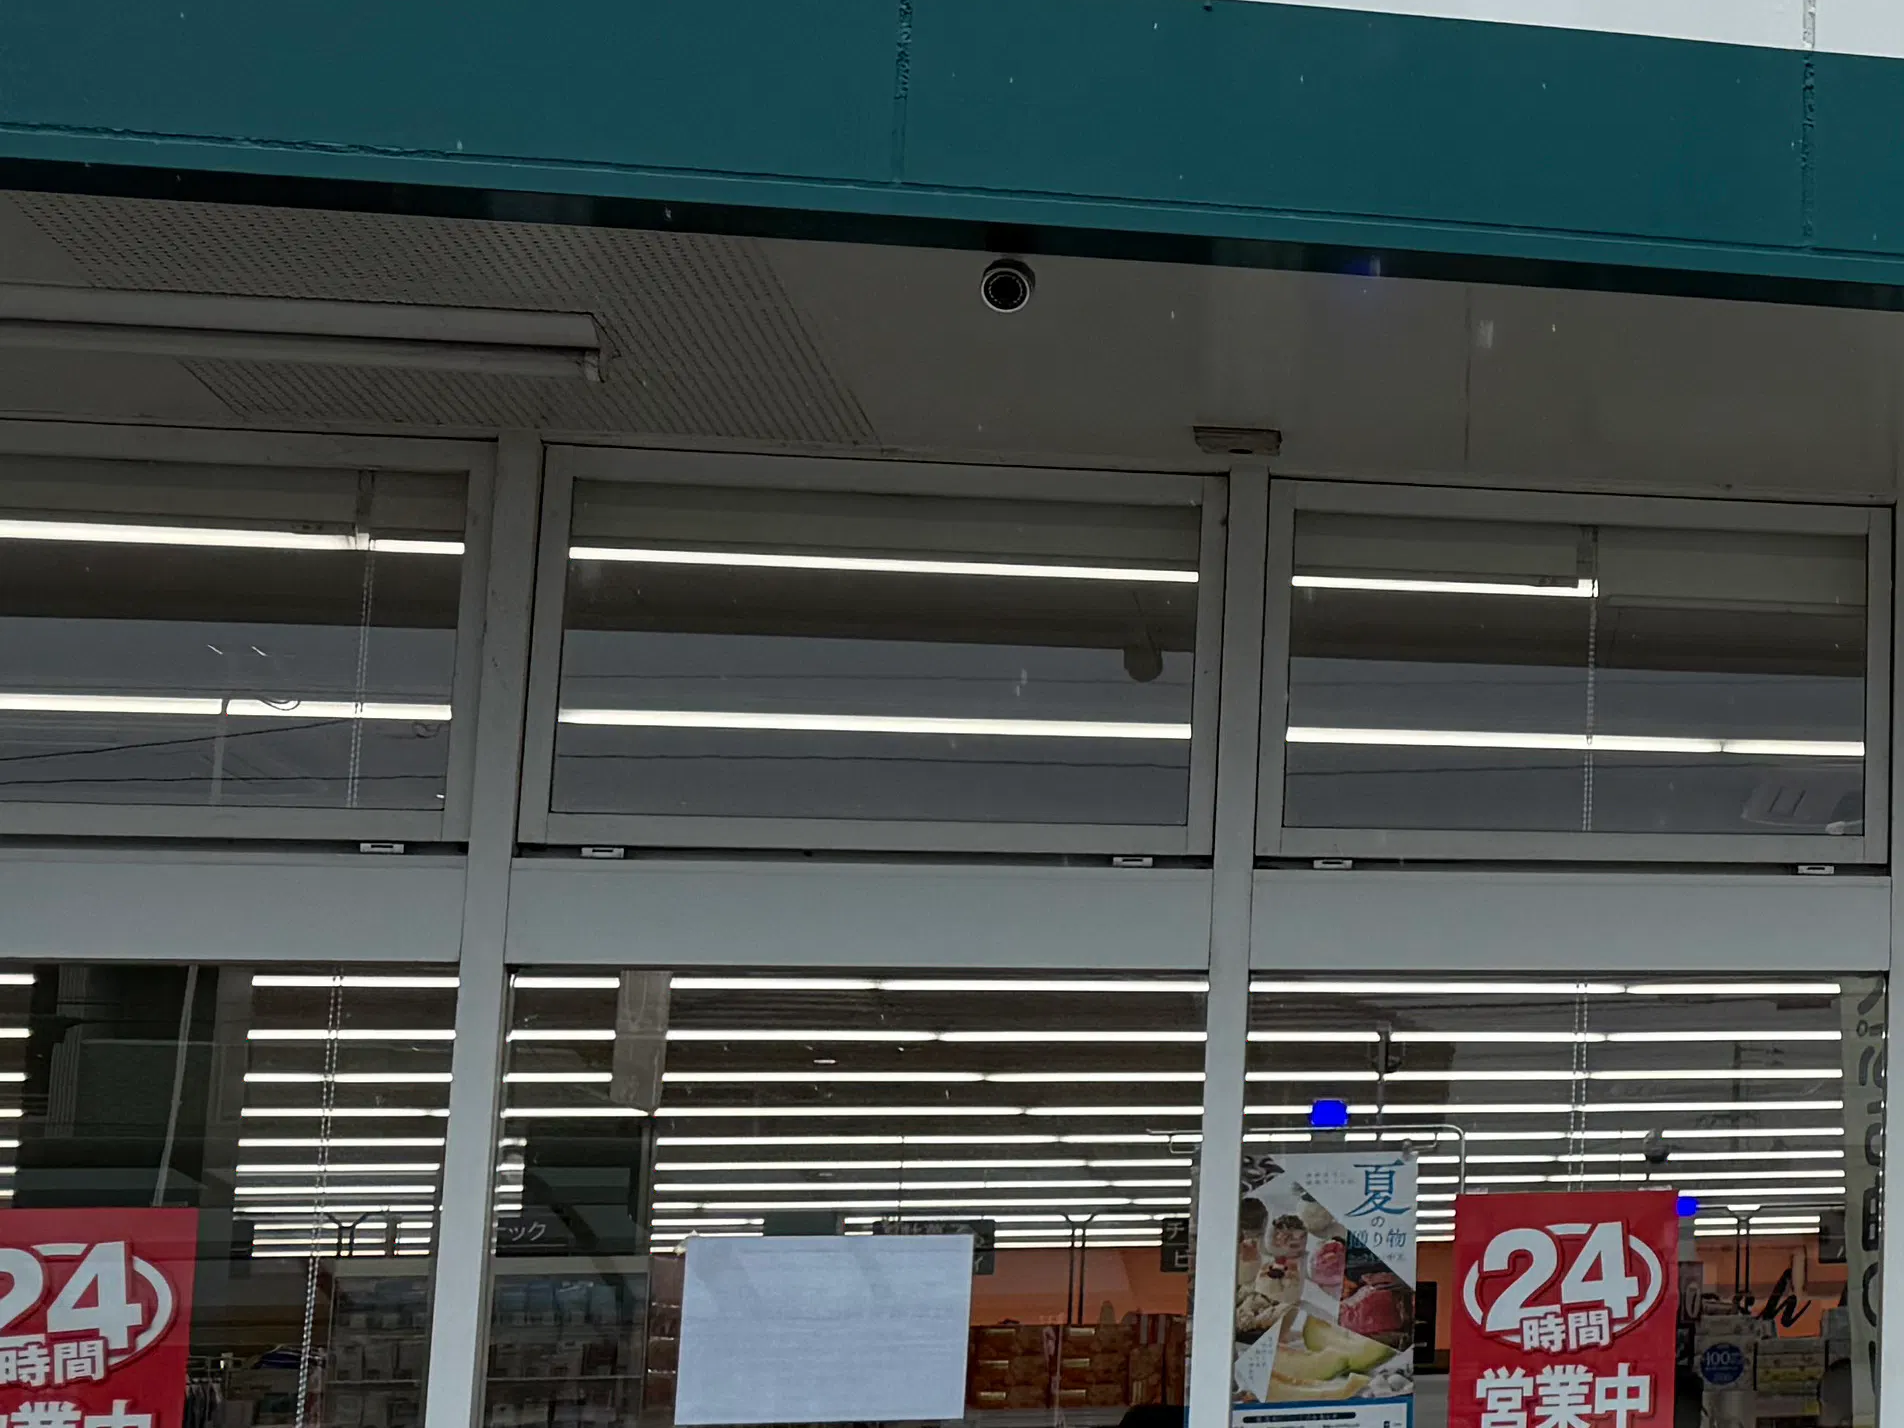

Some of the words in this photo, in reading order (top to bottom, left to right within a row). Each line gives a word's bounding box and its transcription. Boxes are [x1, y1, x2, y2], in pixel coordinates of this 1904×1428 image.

[1345, 1159, 1412, 1217] 夏
[497, 1221, 546, 1243] ック
[1483, 1222, 1640, 1333] 24
[1521, 1309, 1613, 1353] 時間
[0, 1339, 105, 1386] 時間
